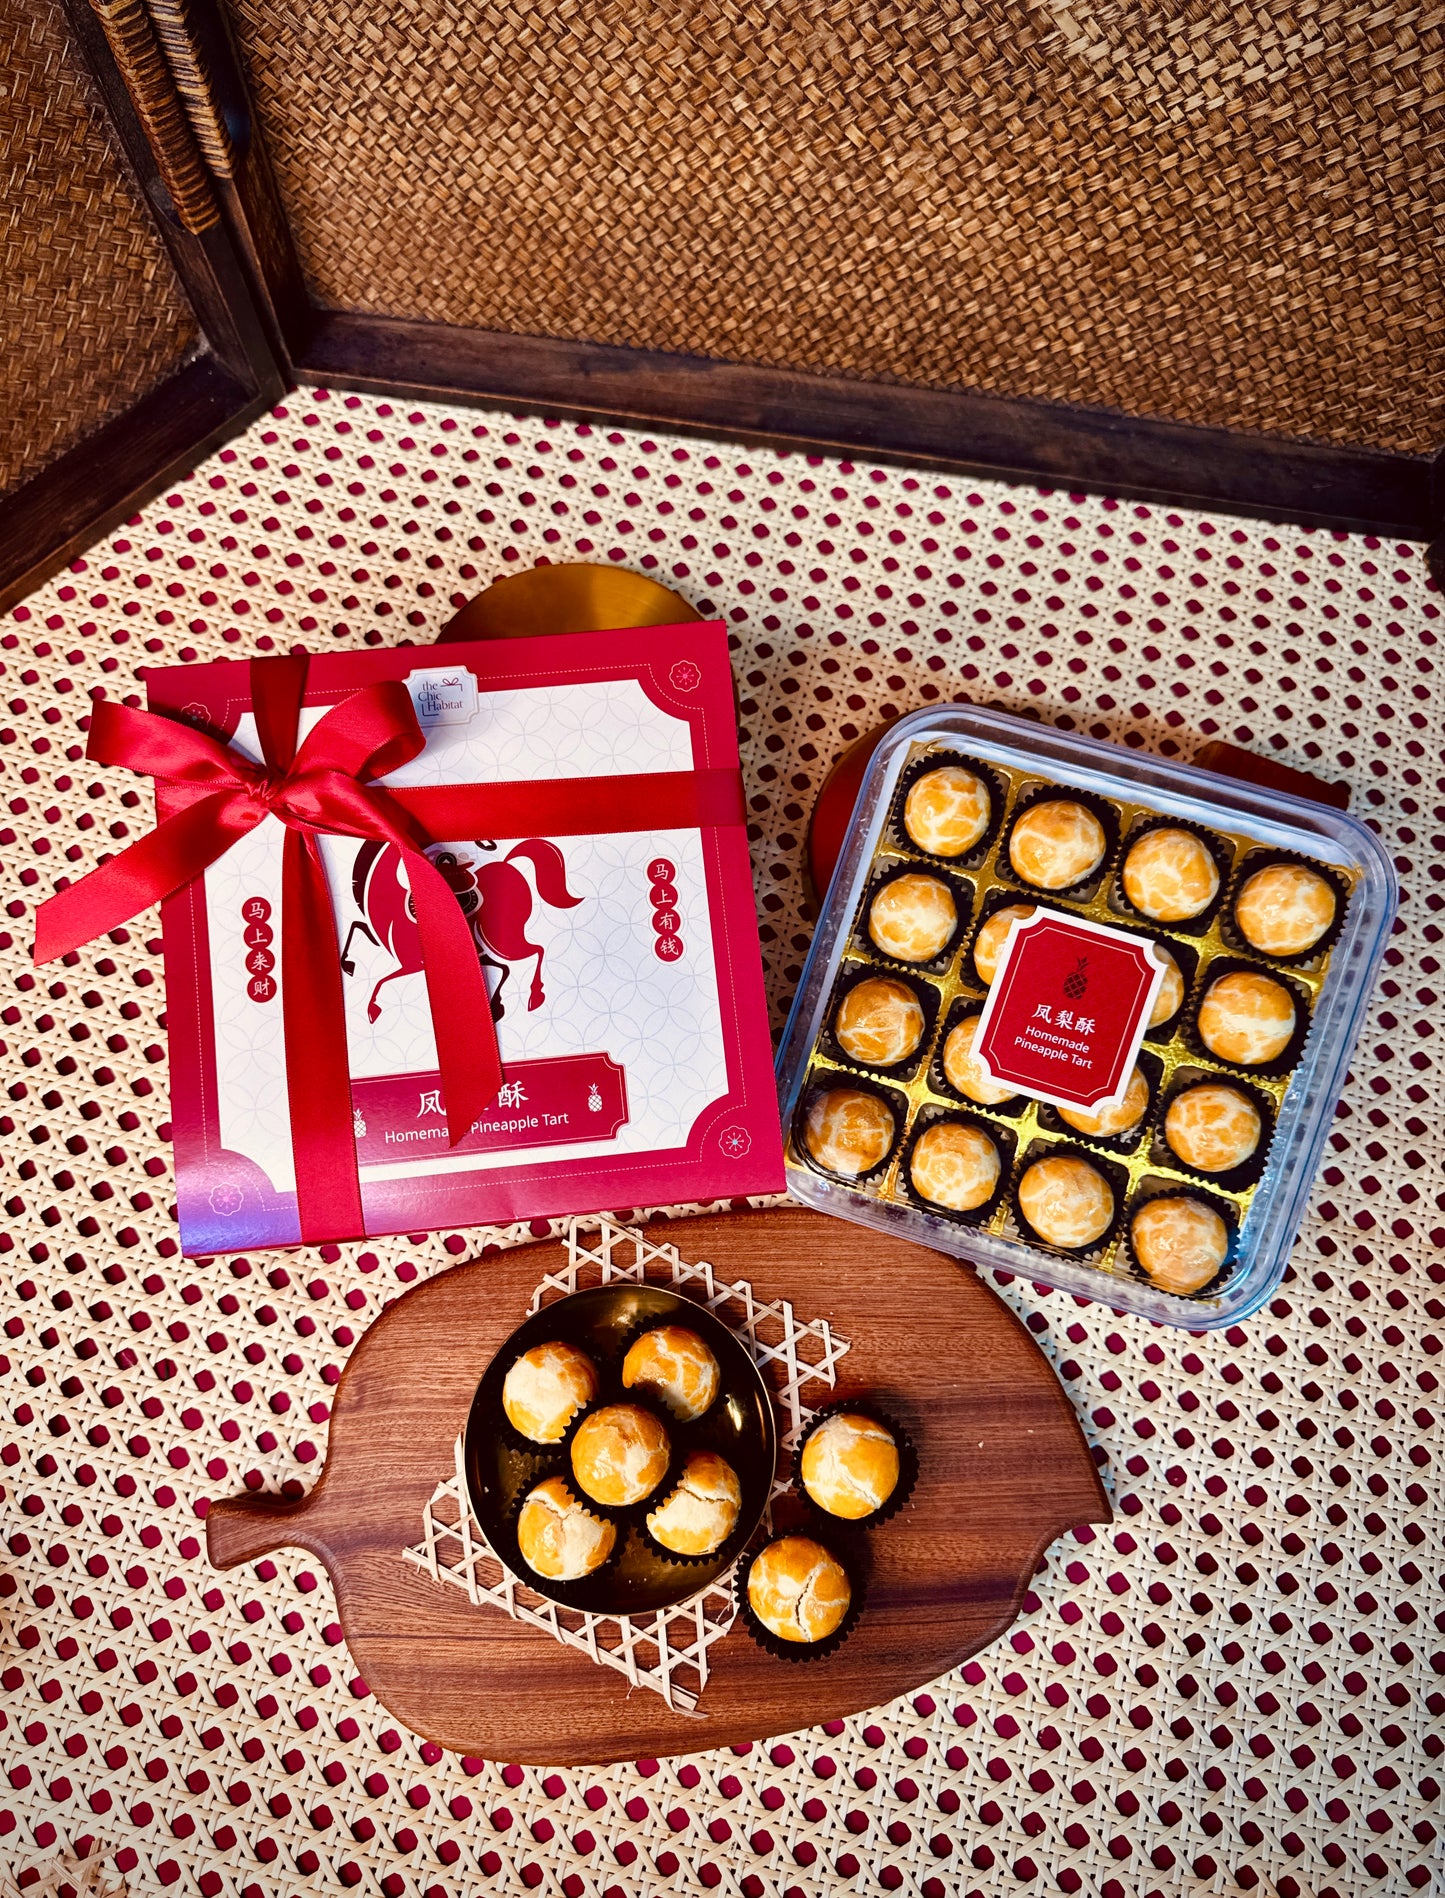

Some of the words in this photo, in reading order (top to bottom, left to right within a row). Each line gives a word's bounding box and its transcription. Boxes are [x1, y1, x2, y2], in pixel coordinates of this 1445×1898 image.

[418, 691, 442, 702] Chic
[422, 680, 438, 691] the
[427, 700, 463, 711] Habitat
[654, 864, 679, 956] 马上有钱
[249, 902, 271, 996] 马上来财
[1032, 1003, 1096, 1036] 凤梨酥
[1014, 1036, 1069, 1062] Pineapple
[1071, 1053, 1093, 1068] Tart
[1025, 1025, 1090, 1054] Homemade
[416, 1080, 529, 1118] 凤酥
[470, 1115, 539, 1135] Pineapple
[542, 1111, 569, 1127] Tart
